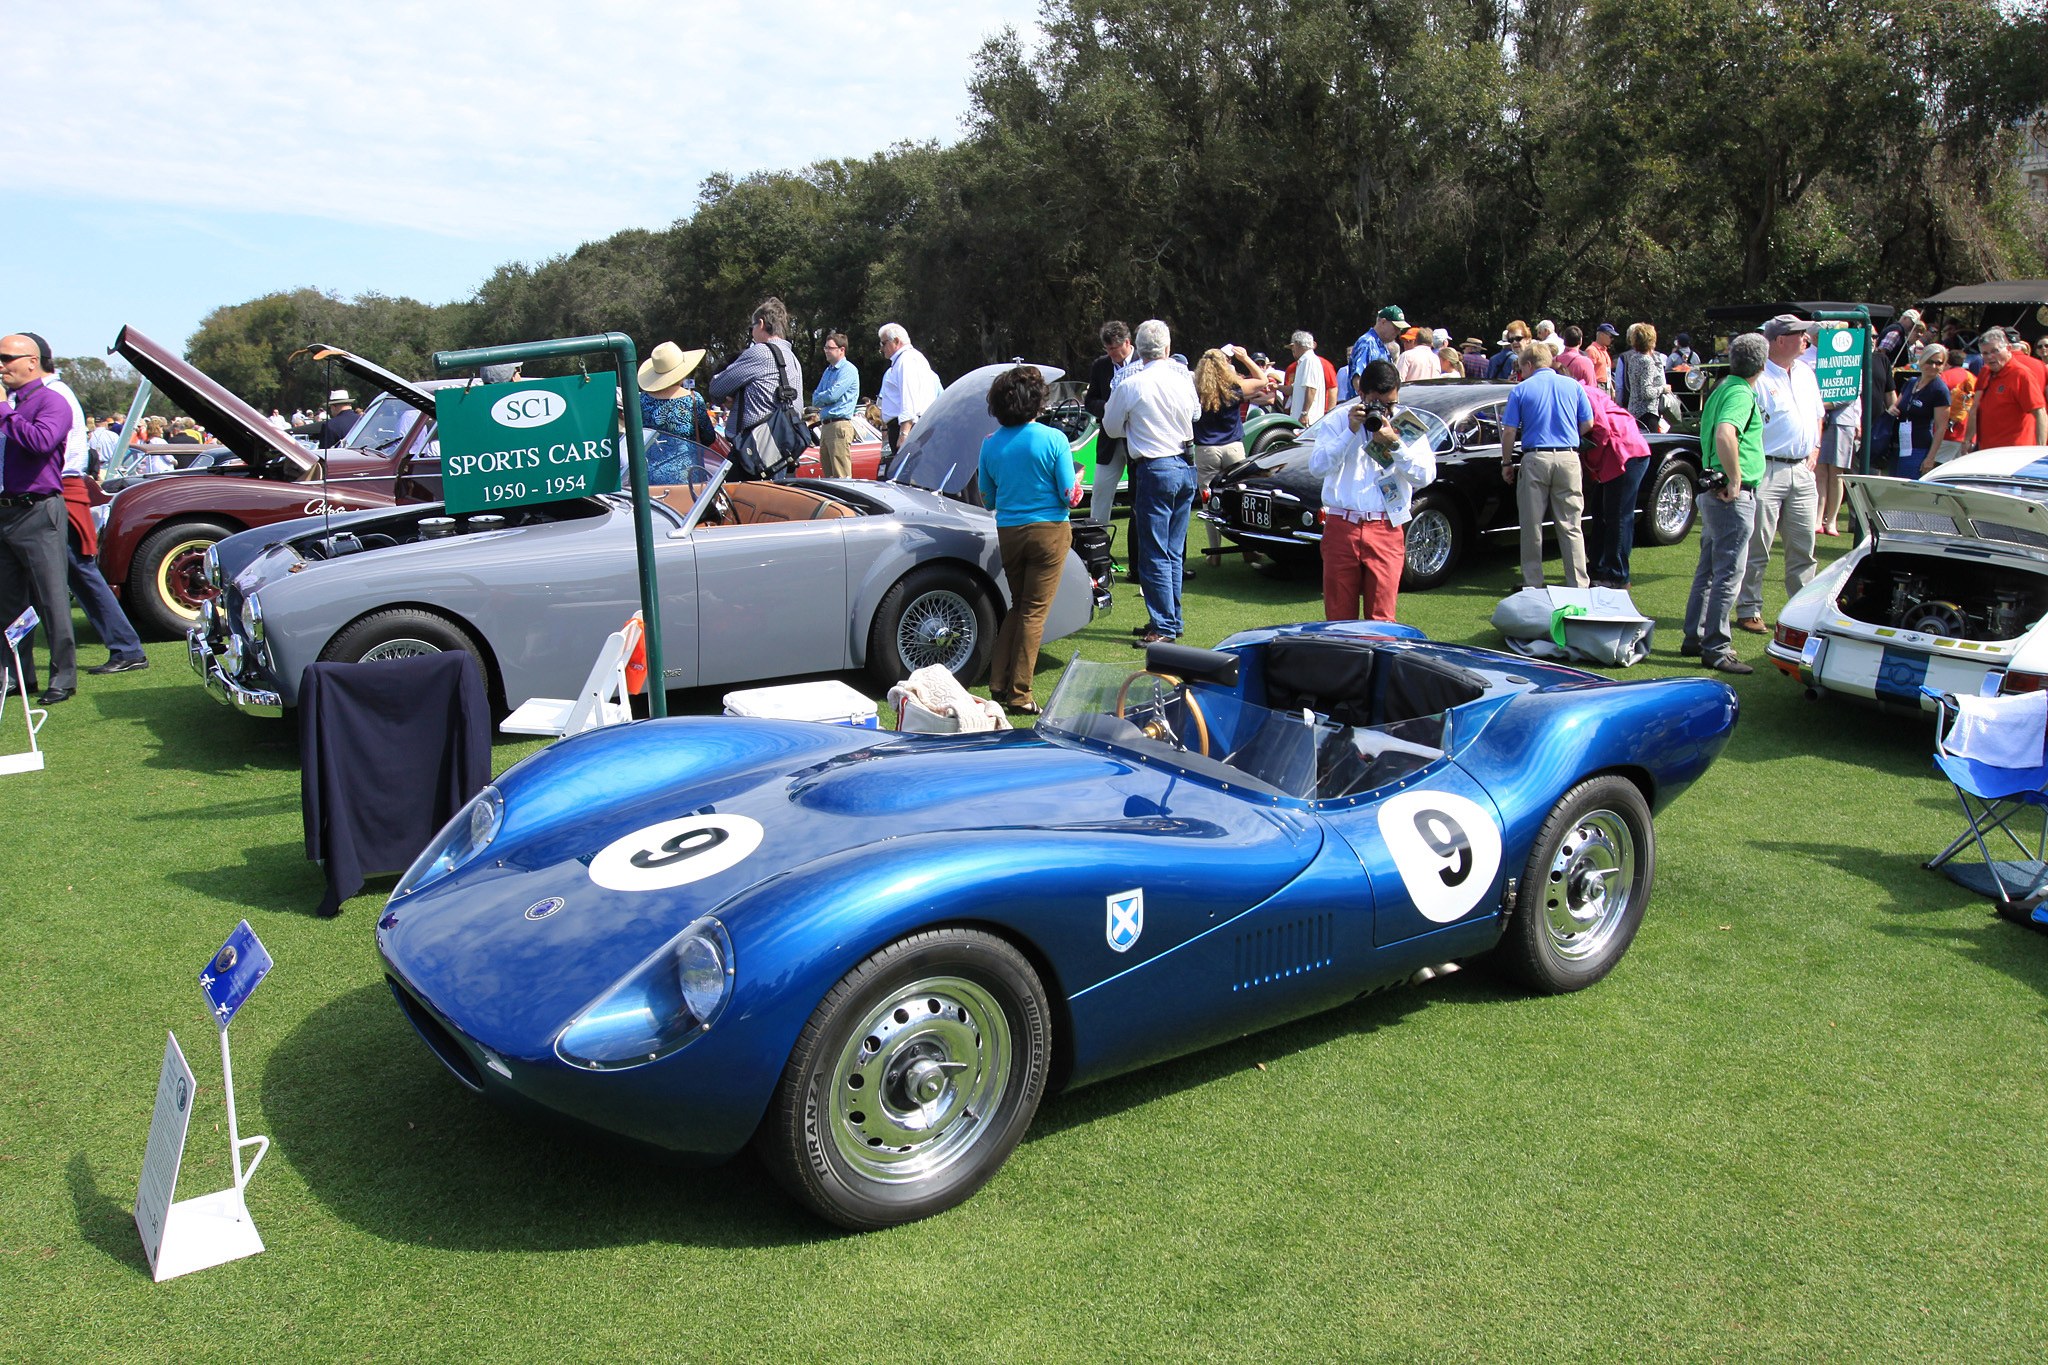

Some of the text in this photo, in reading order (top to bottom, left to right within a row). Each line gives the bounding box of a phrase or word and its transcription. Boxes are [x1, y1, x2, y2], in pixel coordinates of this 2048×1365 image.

[1834, 335, 1850, 348] MAS
[1828, 355, 1861, 368] ANNIVERSARY
[1820, 387, 1857, 398] TREET CARS
[1822, 376, 1853, 388] MASERATI
[506, 397, 551, 420] SC1
[448, 438, 613, 477] SPORTS CARS
[483, 482, 526, 503] 1950
[545, 474, 586, 495] 1954
[1245, 510, 1270, 525] 1188
[630, 827, 729, 869] 9
[1413, 809, 1473, 887] 9
[1022, 995, 1043, 1104] BRIDGESTONE
[806, 1072, 829, 1181] TURANZA
